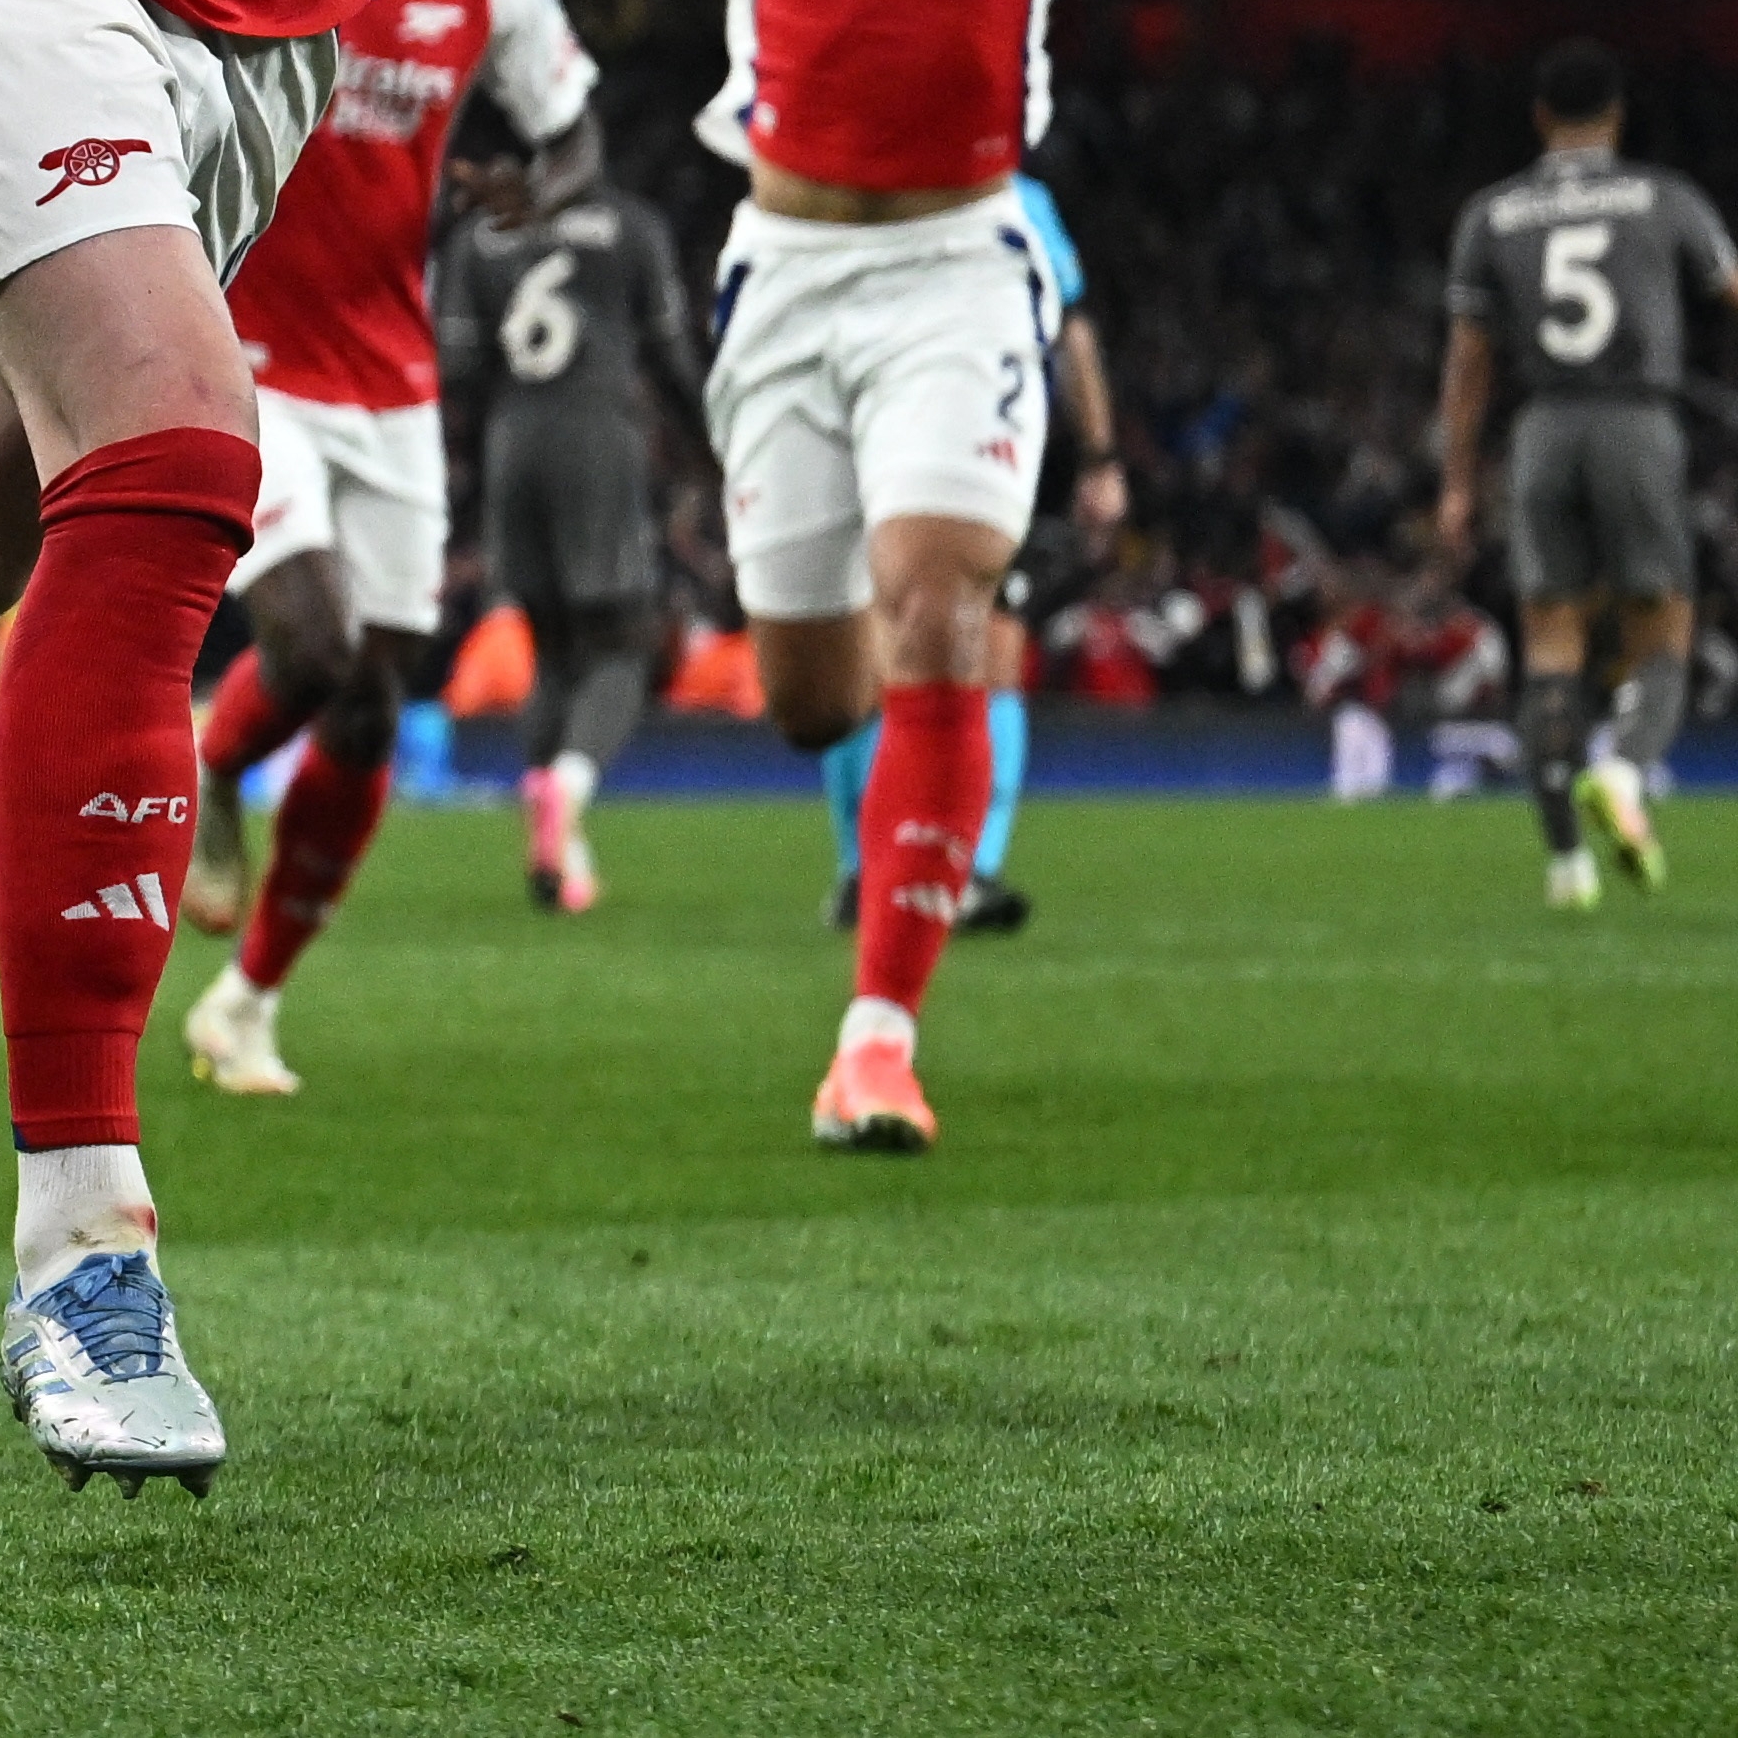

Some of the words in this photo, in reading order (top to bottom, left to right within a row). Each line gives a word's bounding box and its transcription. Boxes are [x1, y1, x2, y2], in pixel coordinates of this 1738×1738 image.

[501, 247, 577, 382] 6
[1539, 224, 1616, 363] 5
[997, 350, 1024, 432] 2
[78, 791, 188, 824] AFC
